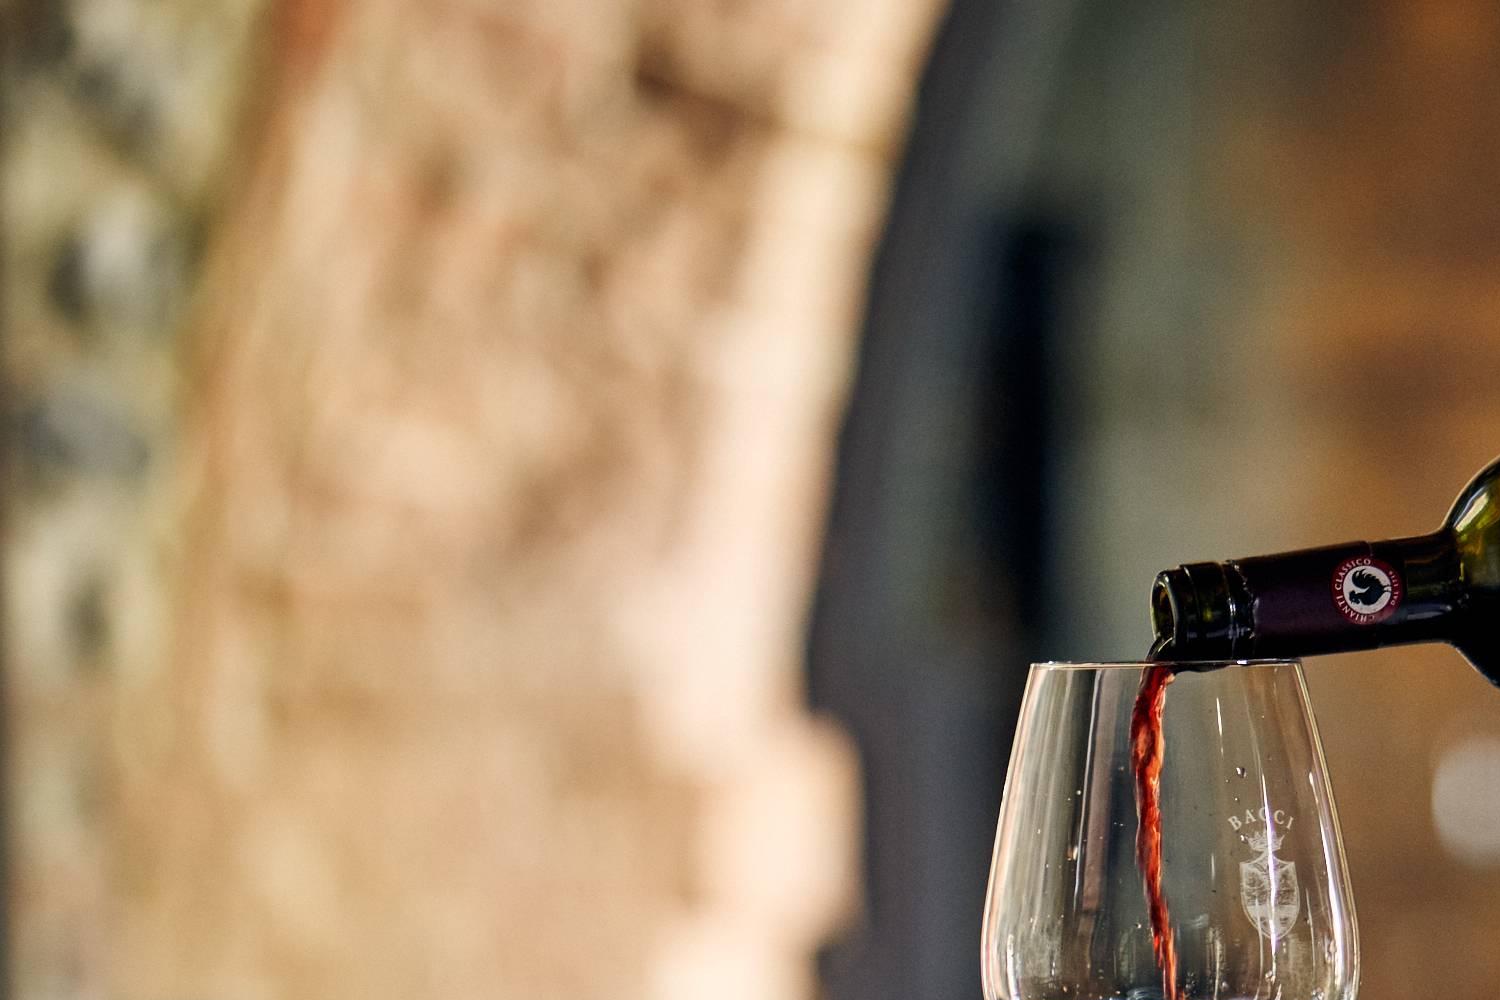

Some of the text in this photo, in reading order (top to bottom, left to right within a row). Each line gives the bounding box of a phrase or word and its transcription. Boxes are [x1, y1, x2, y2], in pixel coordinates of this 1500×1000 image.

[1335, 559, 1375, 622] CHIANTI CLASSICO
[1228, 808, 1294, 831] BACCI
